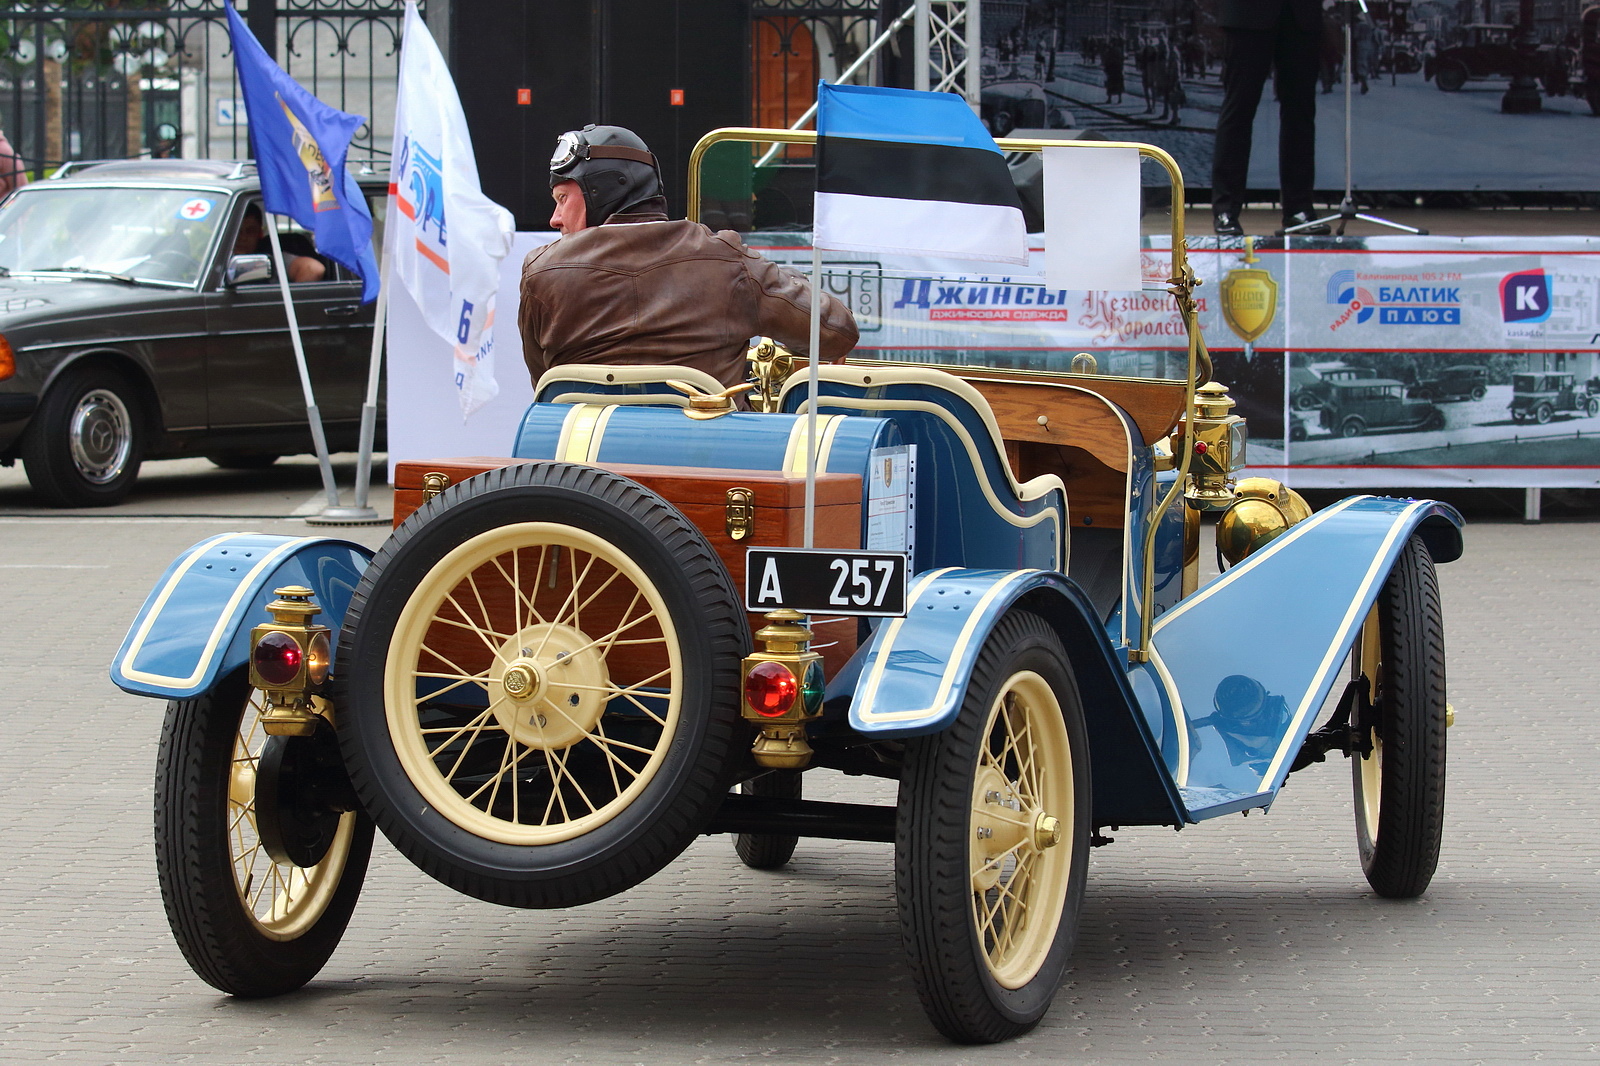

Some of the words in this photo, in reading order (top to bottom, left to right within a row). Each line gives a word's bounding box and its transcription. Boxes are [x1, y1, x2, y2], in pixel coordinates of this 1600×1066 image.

[1356, 272, 1418, 282] Калининград
[1421, 272, 1445, 281] 105.2
[1447, 272, 1462, 281] FM
[893, 276, 1068, 309] Джинсы
[1379, 286, 1461, 303] БАЛТИК
[931, 311, 1010, 319] ДЖИНСОВАЯ
[1013, 312, 1066, 320] ОДЕЖДА
[1329, 300, 1362, 332] РАДИО
[1386, 309, 1454, 323] ПЛЮС
[757, 557, 784, 604] A
[829, 558, 895, 607] 257
